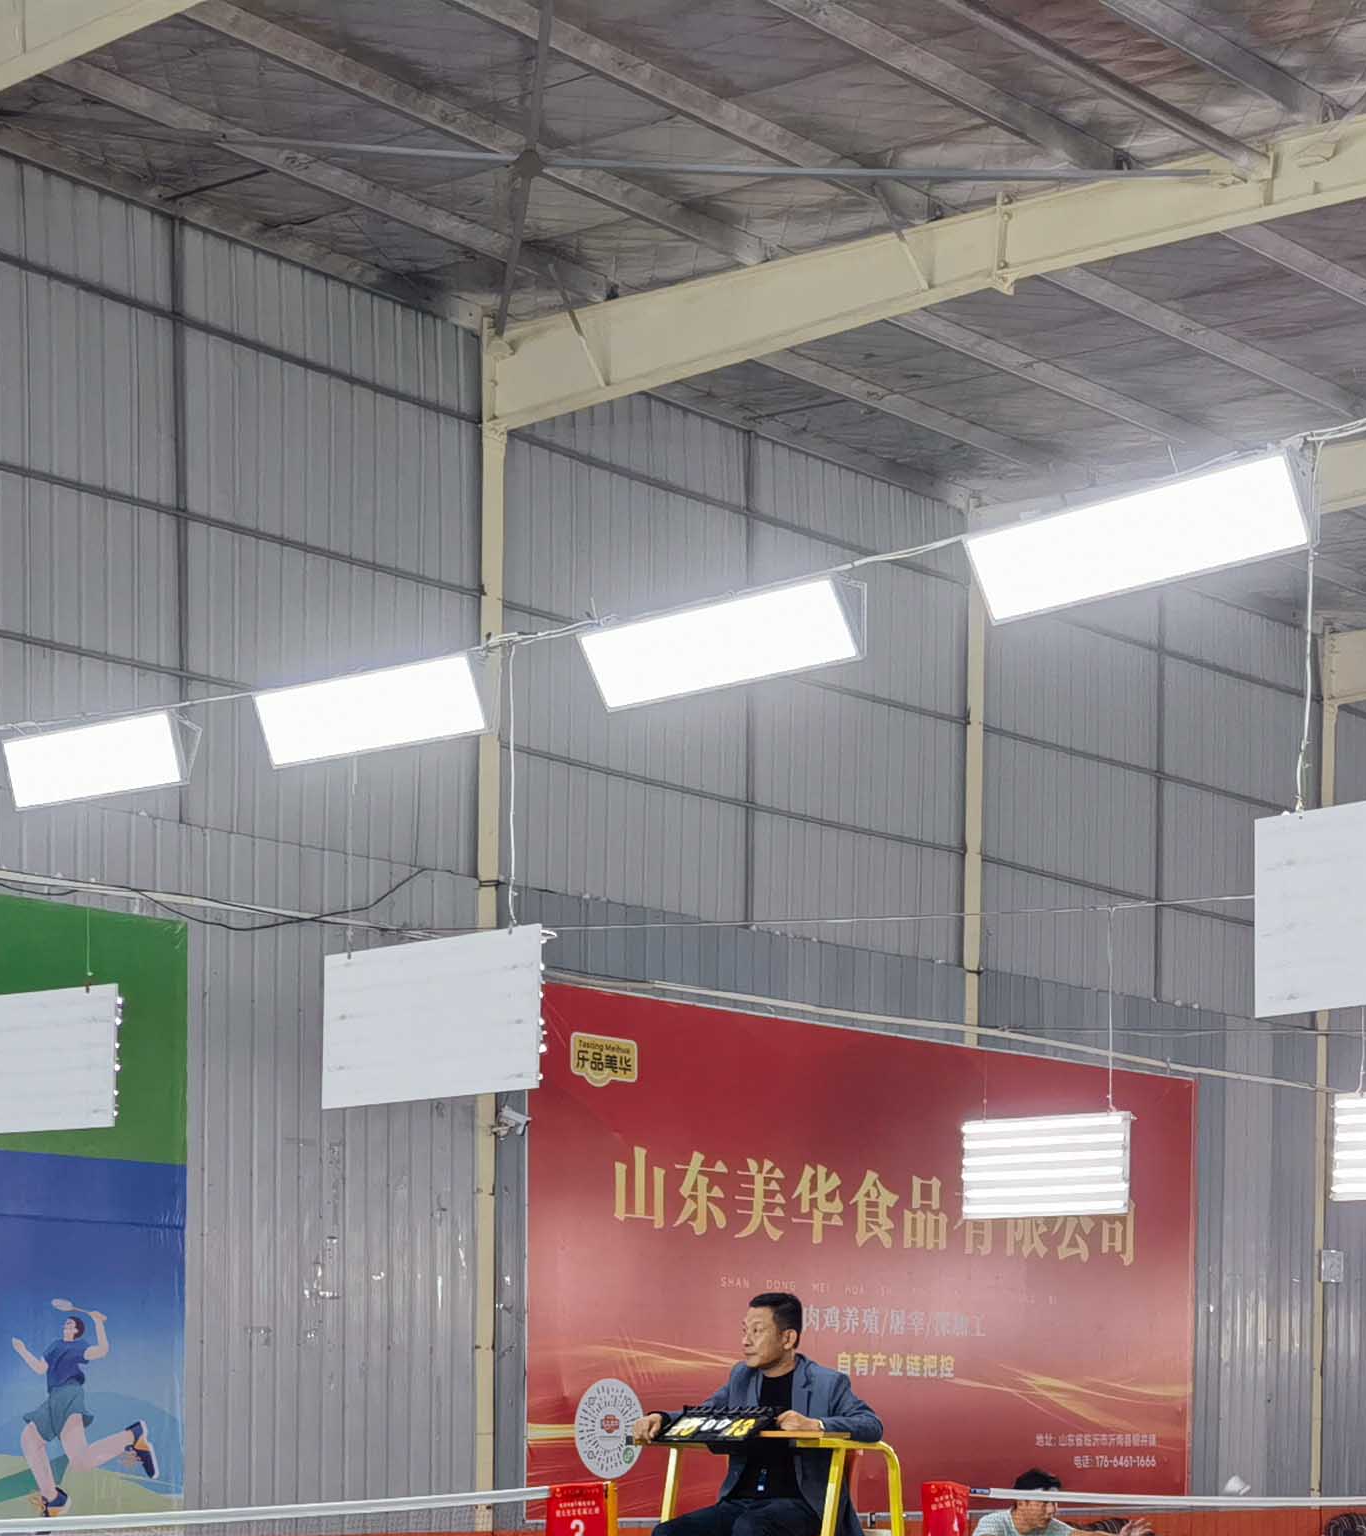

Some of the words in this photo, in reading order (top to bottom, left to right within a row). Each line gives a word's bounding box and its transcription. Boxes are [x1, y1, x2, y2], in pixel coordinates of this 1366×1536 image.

[837, 1351, 956, 1378] 自有产业链把控
